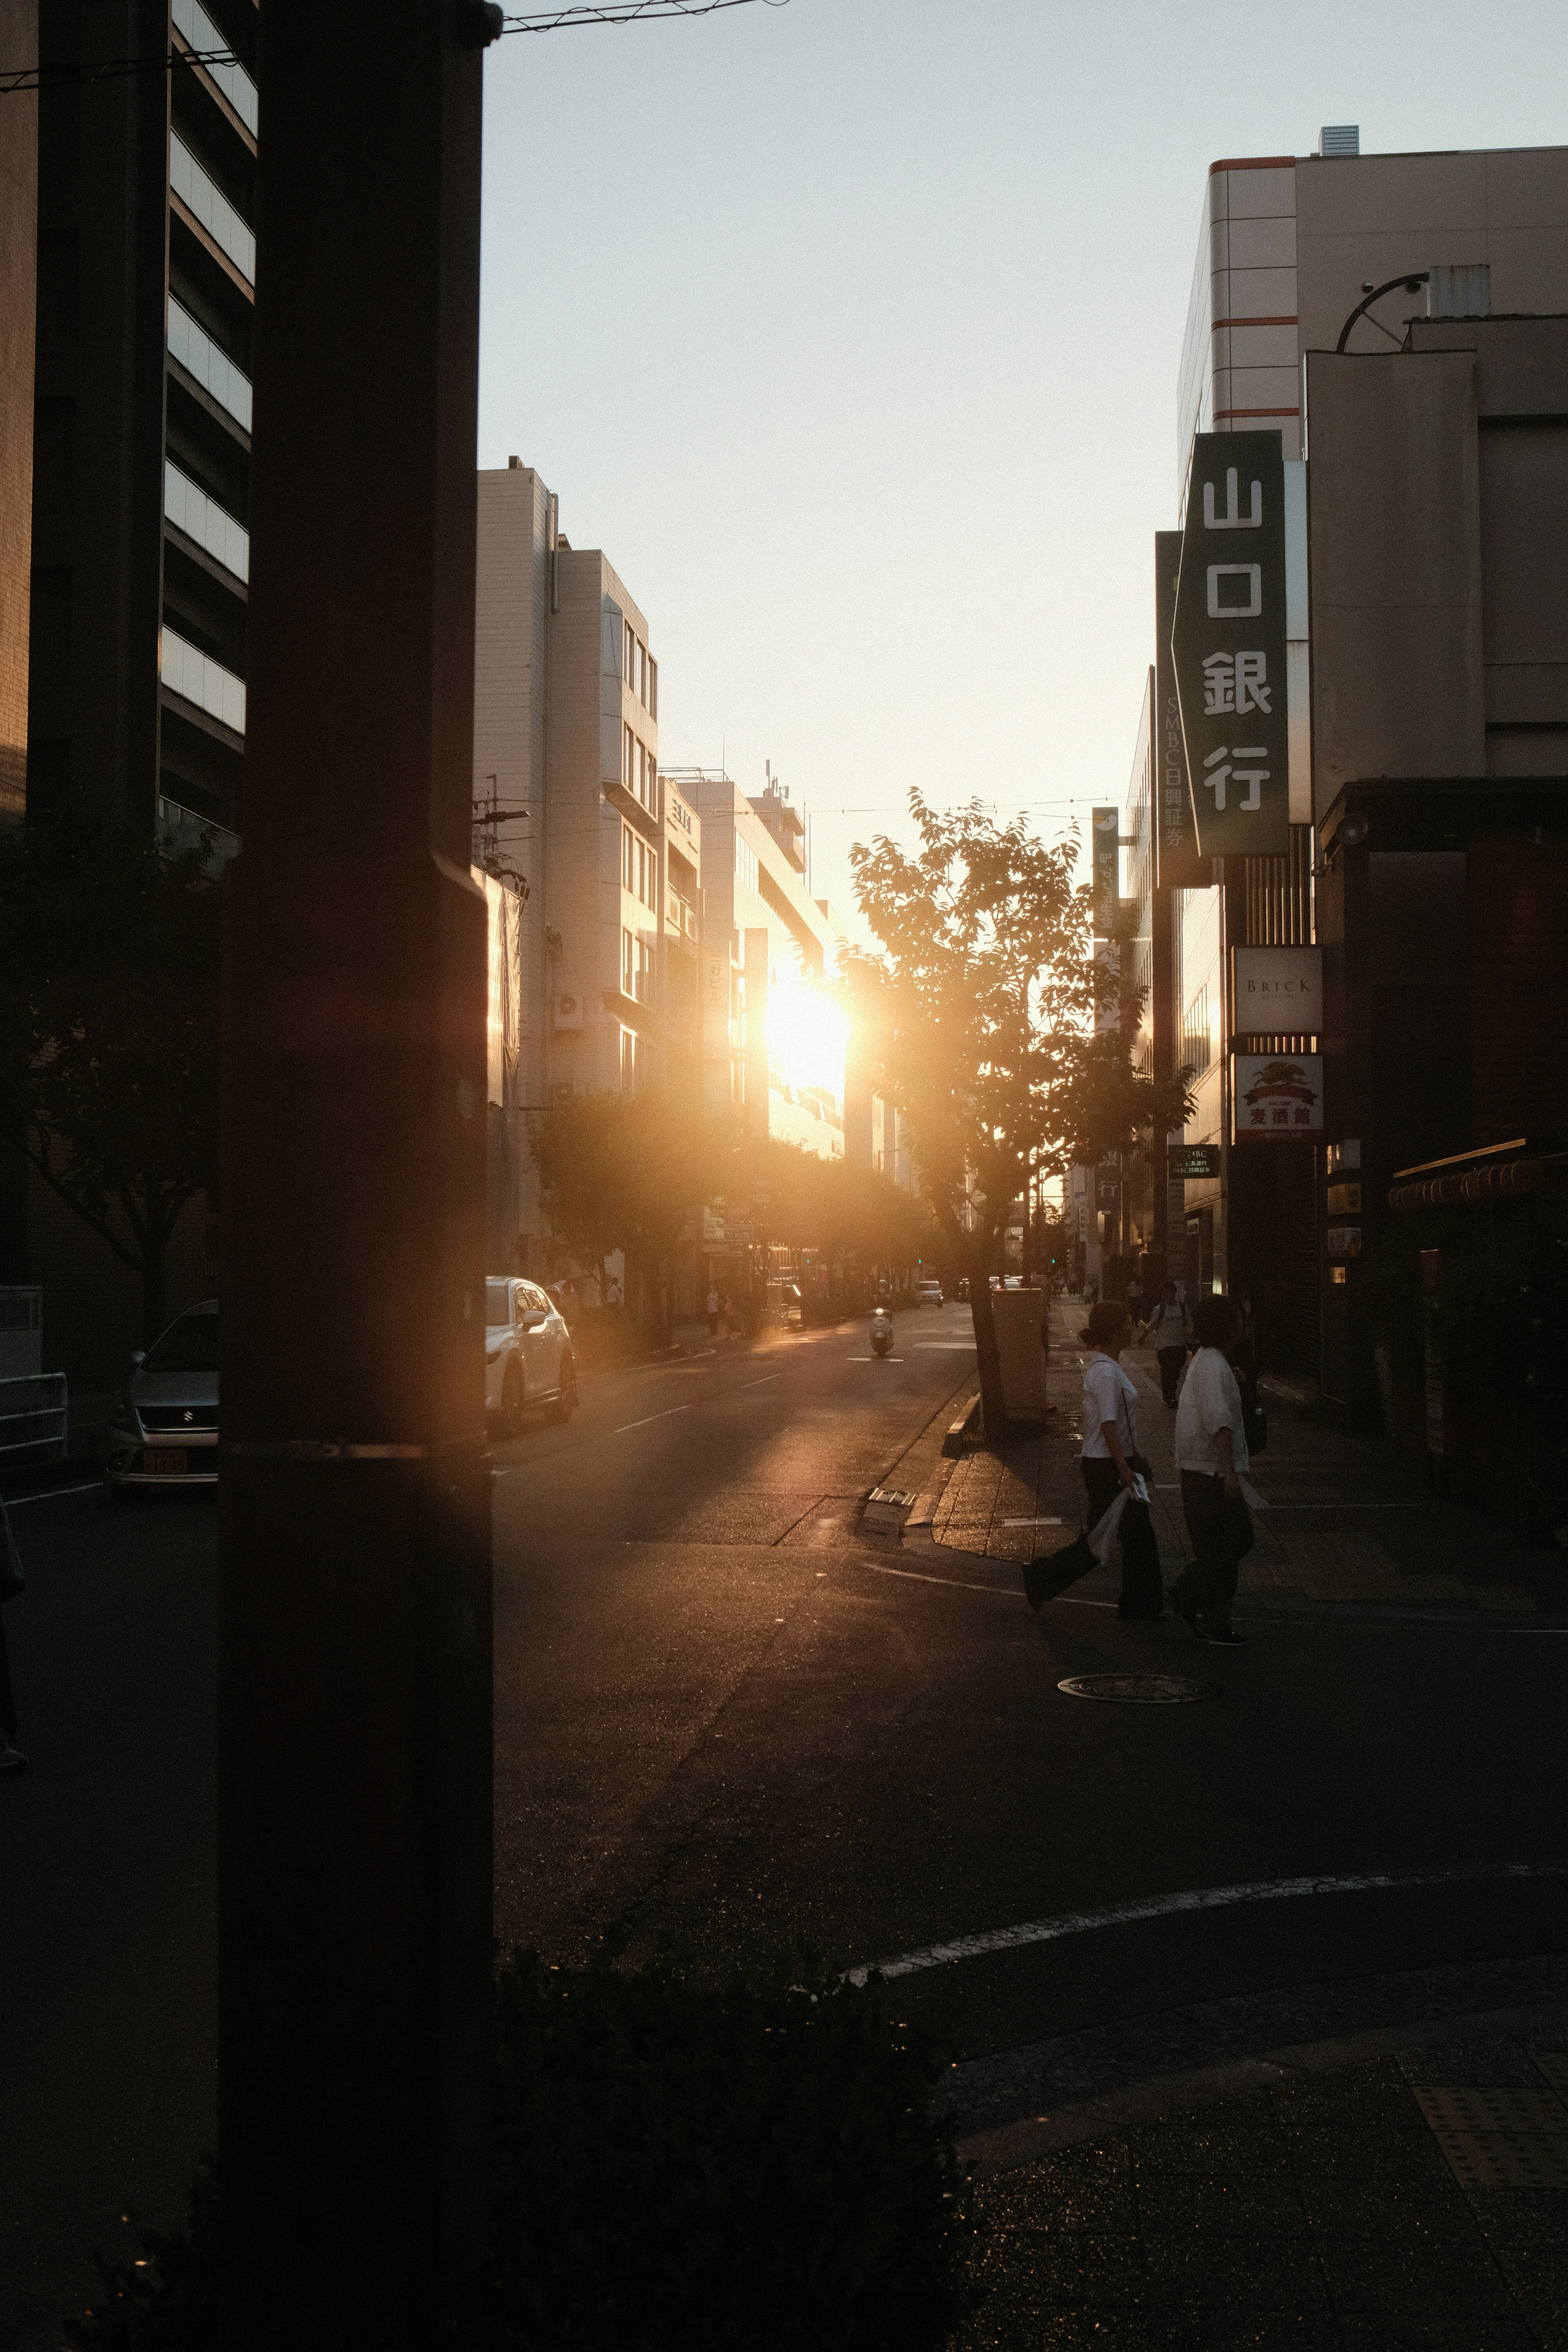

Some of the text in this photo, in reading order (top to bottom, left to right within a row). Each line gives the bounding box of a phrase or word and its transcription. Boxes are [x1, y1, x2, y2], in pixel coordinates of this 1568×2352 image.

[1202, 467, 1272, 810] 山口銀行
[1165, 697, 1183, 846] SMBC日興証券
[1248, 979, 1310, 992] BRICK
[1250, 1108, 1310, 1124] 麦酒館
